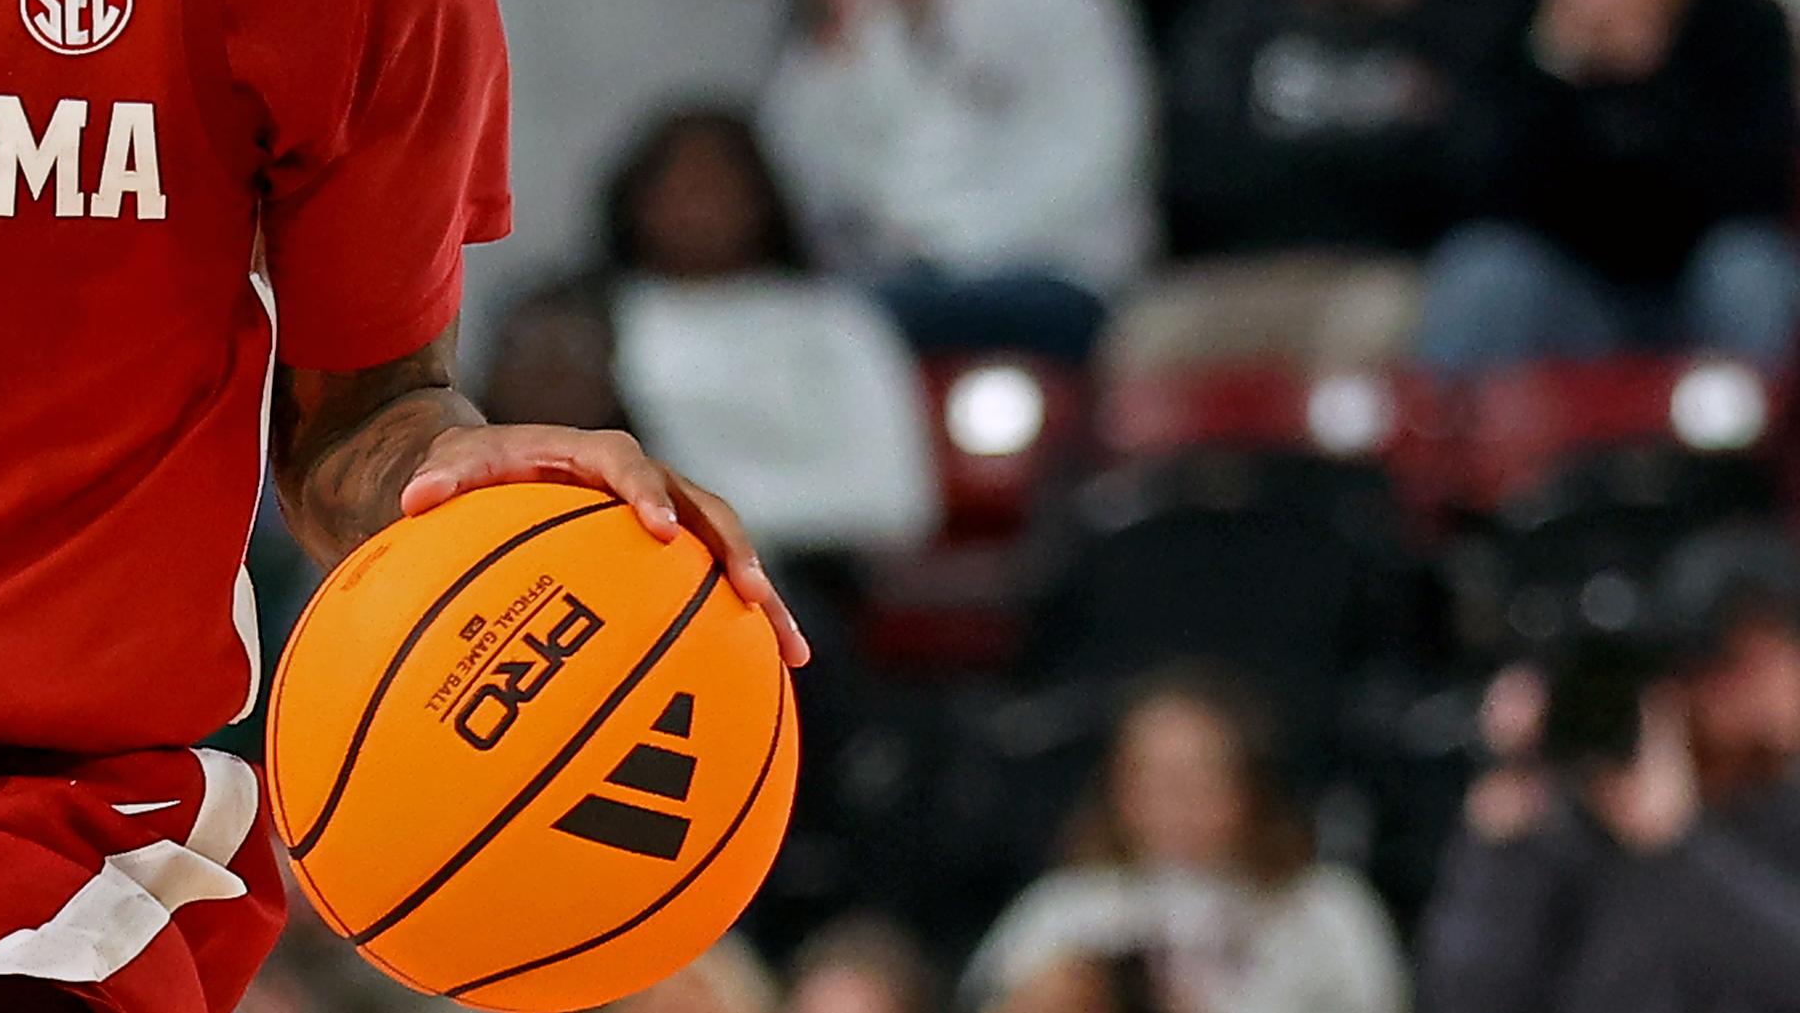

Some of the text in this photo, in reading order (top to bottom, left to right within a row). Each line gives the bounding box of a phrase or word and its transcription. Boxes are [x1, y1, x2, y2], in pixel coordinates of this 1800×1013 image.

[493, 574, 554, 629] OFFICIAL
[454, 592, 606, 751] PRO
[456, 631, 498, 675] GAME
[424, 673, 462, 712] BALL
